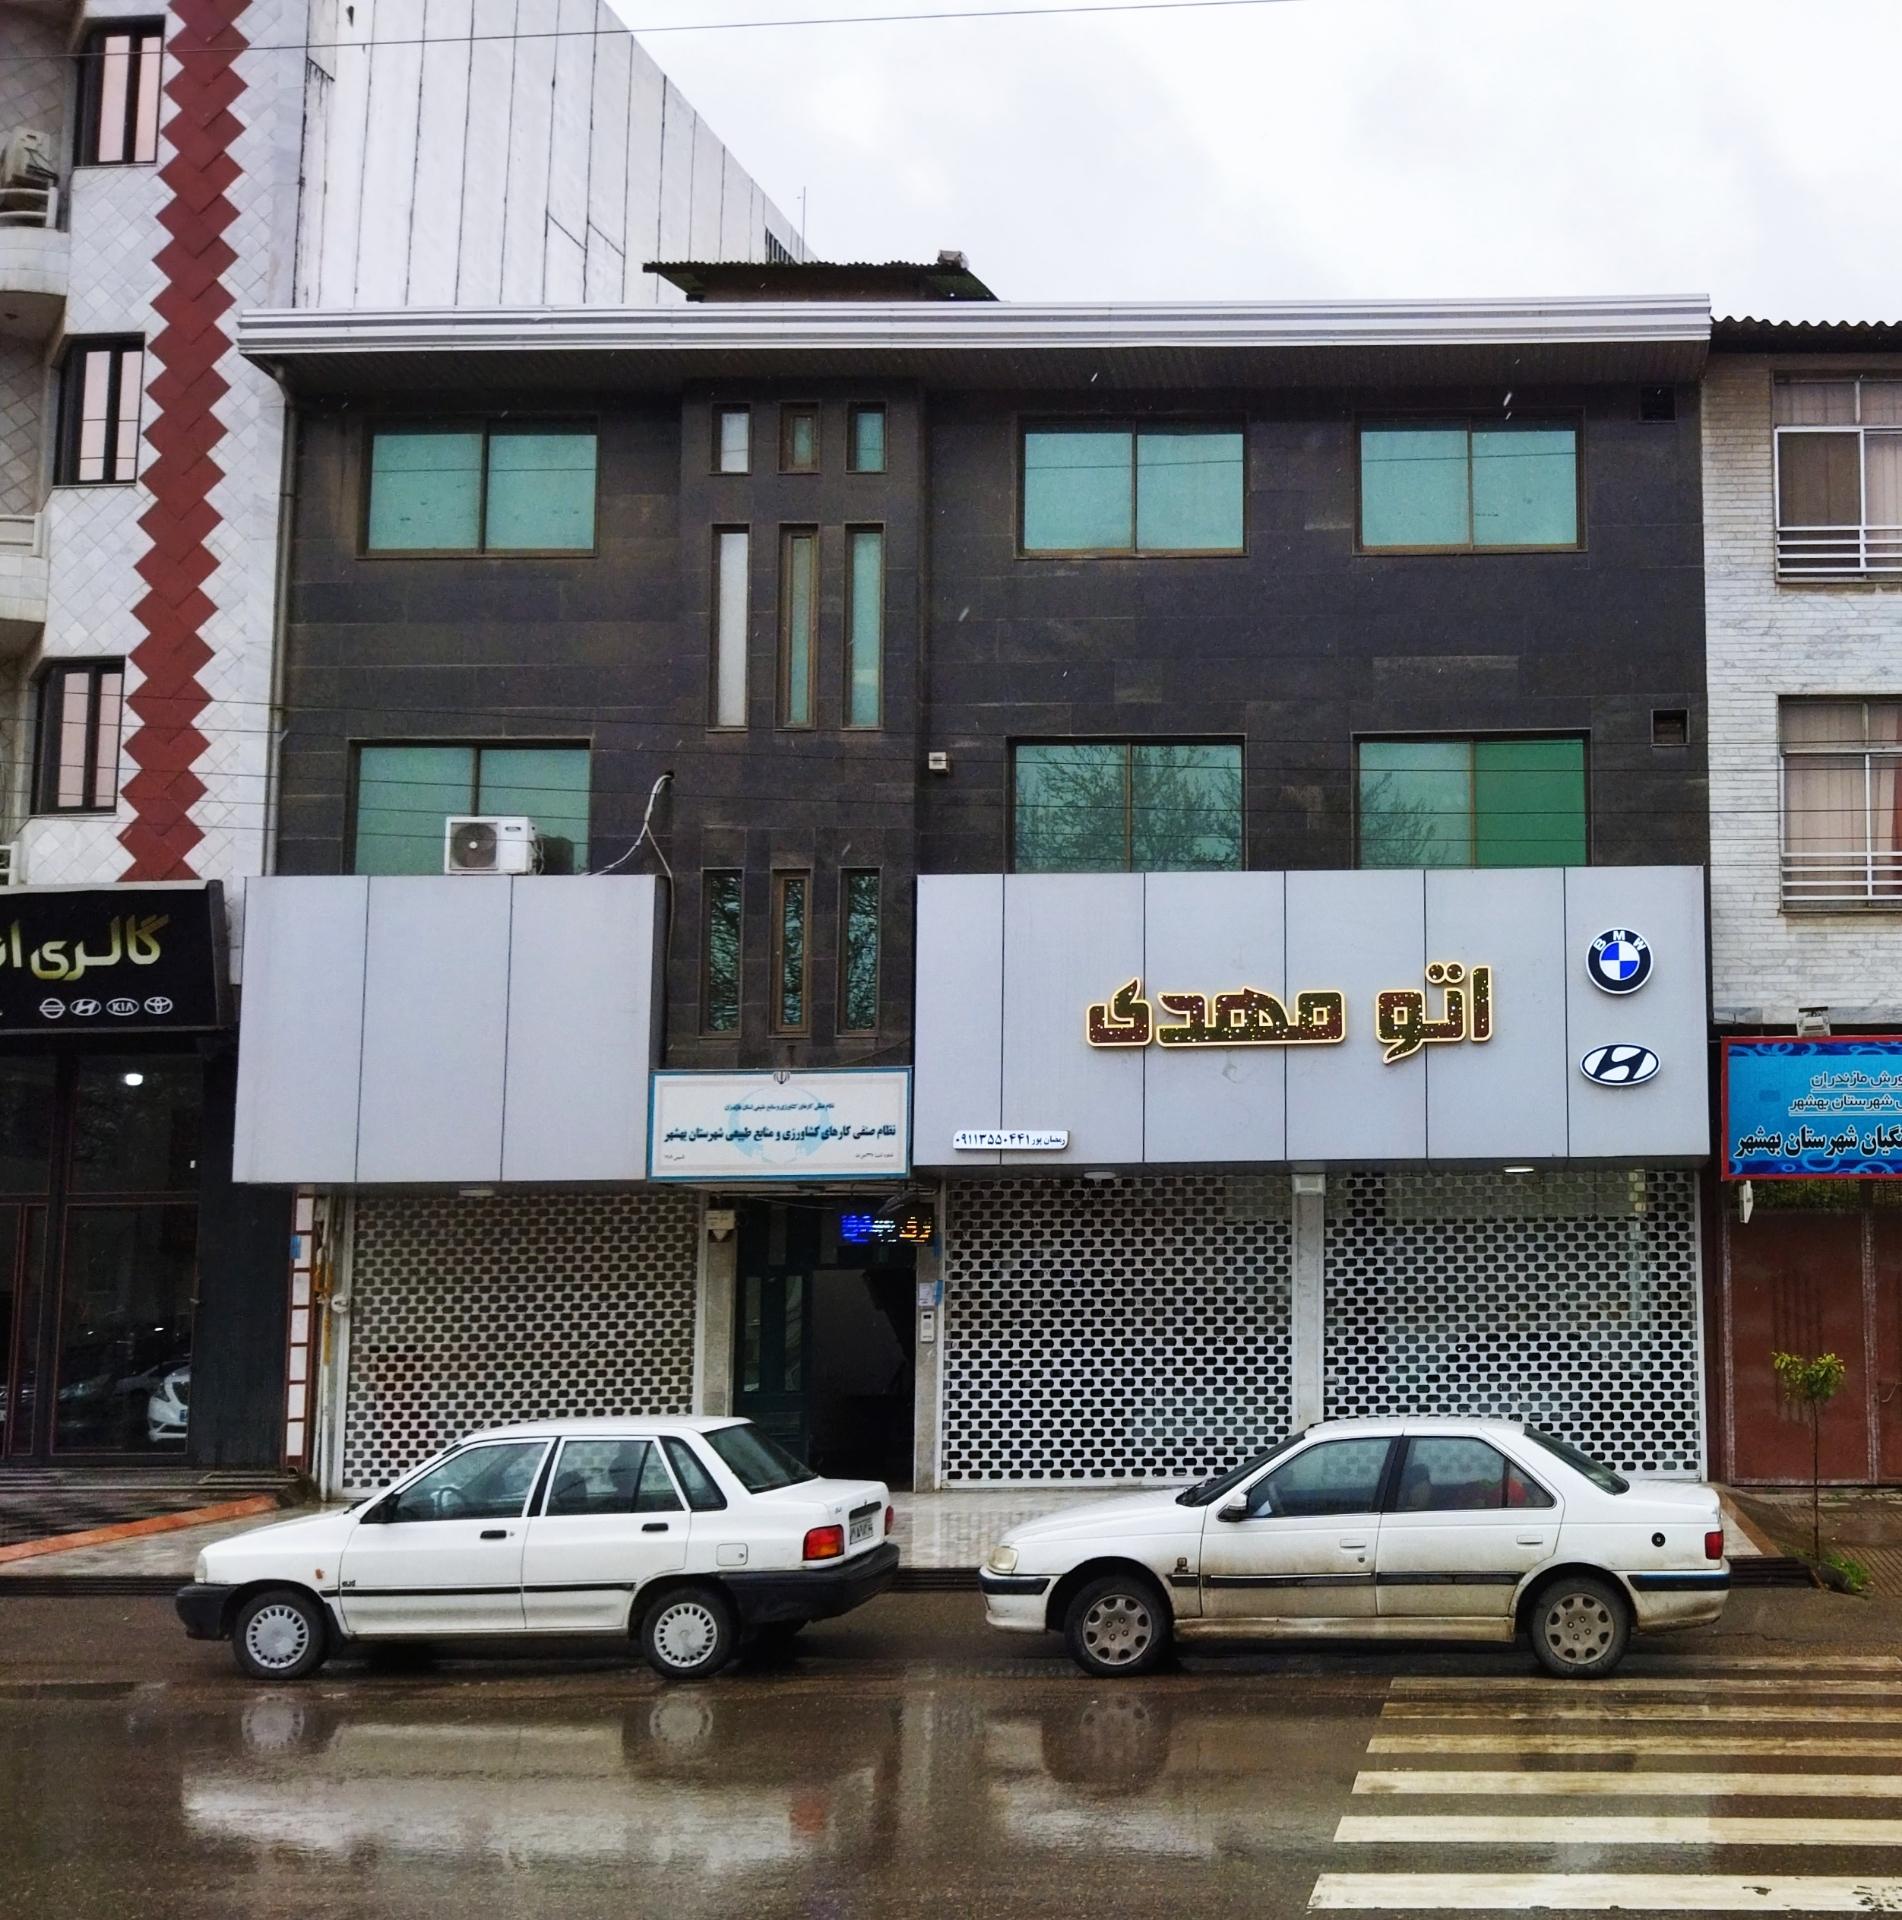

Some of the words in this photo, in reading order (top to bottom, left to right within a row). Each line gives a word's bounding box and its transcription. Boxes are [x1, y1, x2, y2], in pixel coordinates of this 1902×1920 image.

[30, 914, 170, 981] گالری
[1593, 930, 1647, 951] BMW
[112, 999, 134, 1012] KIA
[1086, 977, 1346, 1047] مهدی
[1375, 961, 1492, 1064] اتو
[1811, 1071, 1868, 1087] مازندران
[1790, 1094, 1829, 1112] بهشهر
[1831, 1094, 1893, 1111] شهرستان
[664, 1127, 688, 1143] بهشهر
[688, 1127, 724, 1142] شهرستان
[725, 1126, 752, 1142] طبیعی
[753, 1126, 775, 1142] منابع
[775, 1130, 781, 1141] و
[782, 1125, 821, 1141] کشاورزی
[820, 1125, 852, 1141] کارهای
[852, 1125, 876, 1140] صنفی
[876, 1124, 897, 1140] نظام
[956, 1133, 1030, 1146] ۰۹۱۱۳۵۵۰۴۴۱
[1785, 1123, 1858, 1157] شهرستان
[1043, 1135, 1066, 1146] رمضان
[1734, 1124, 1783, 1159] بهشهر
